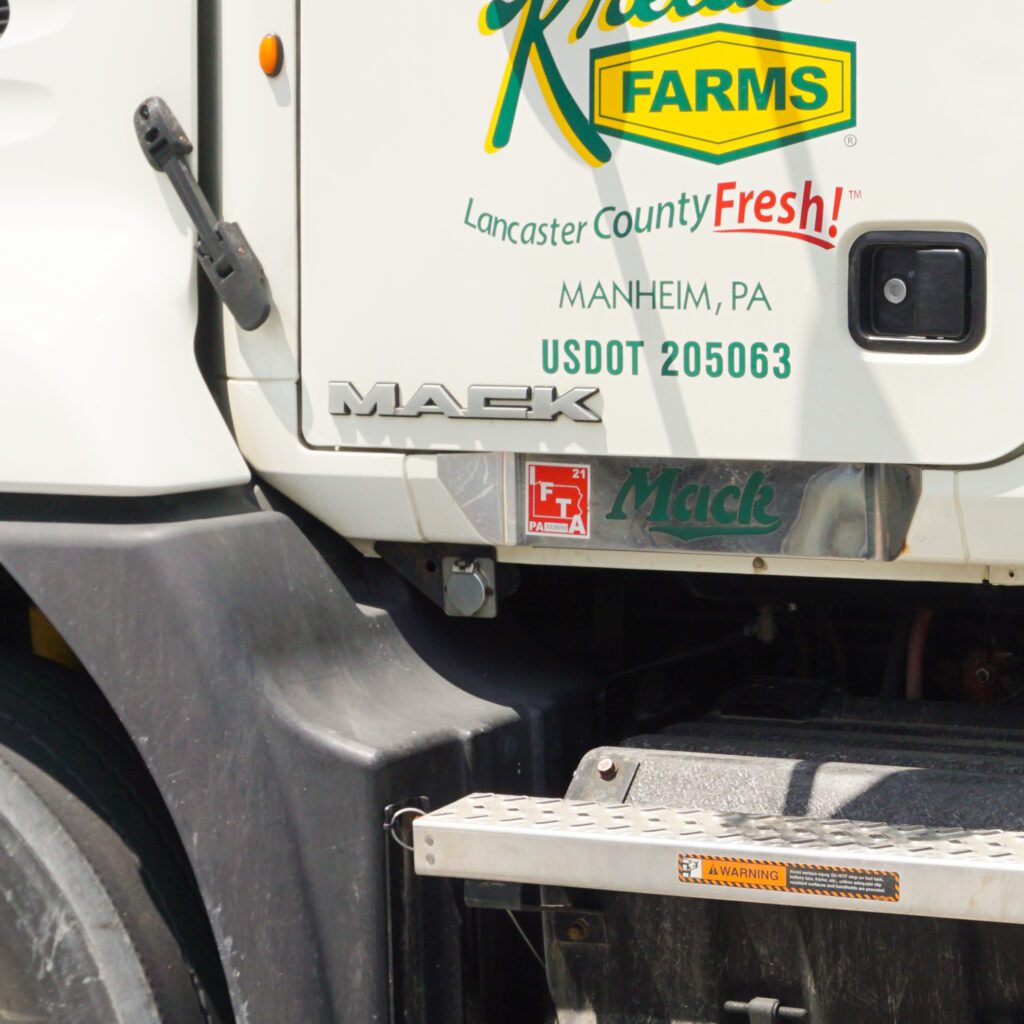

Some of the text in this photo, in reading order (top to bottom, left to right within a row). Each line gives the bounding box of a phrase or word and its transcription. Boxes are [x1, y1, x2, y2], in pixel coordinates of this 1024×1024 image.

[621, 66, 829, 114] FARMS
[463, 197, 588, 246] Lancaster
[593, 192, 711, 240] County
[714, 180, 843, 239] Fresh!
[559, 280, 772, 315] MANHEIM, PA
[541, 339, 791, 379] USDOT 205063
[329, 380, 603, 423] MACK
[572, 468, 586, 480] 21
[606, 467, 781, 528] Mack
[529, 521, 544, 532] PA
[720, 865, 779, 881] WARNING
